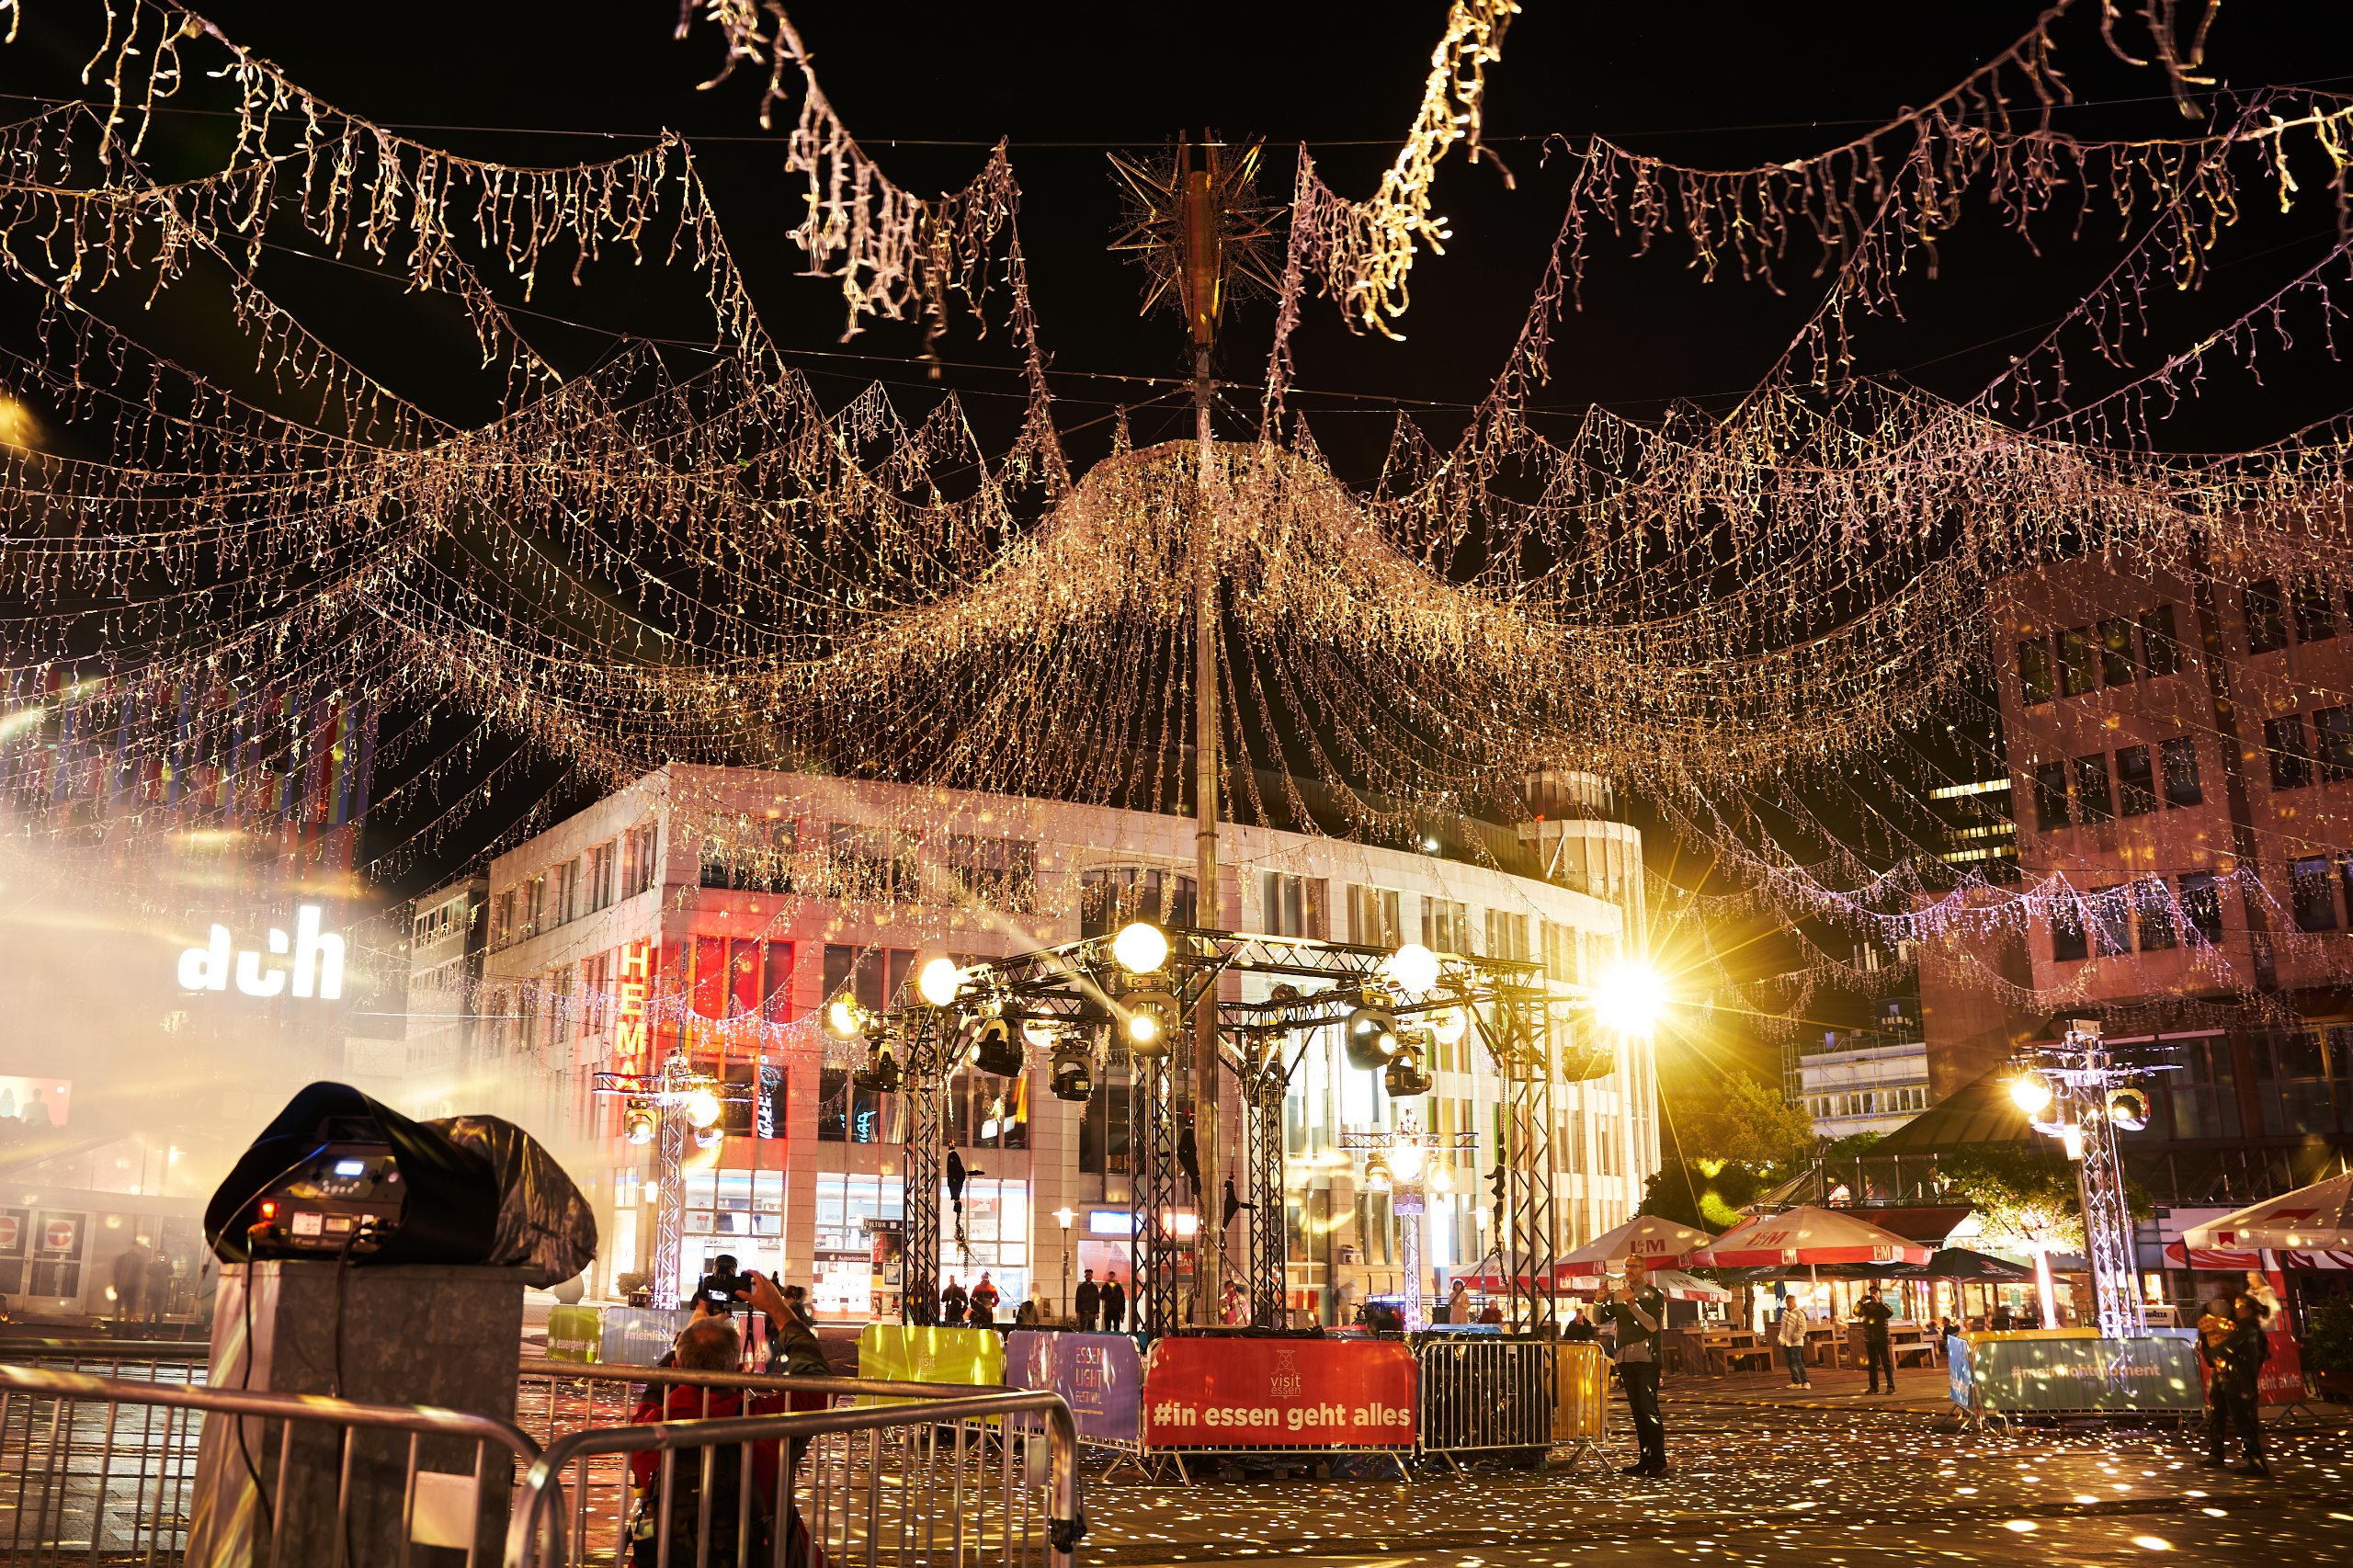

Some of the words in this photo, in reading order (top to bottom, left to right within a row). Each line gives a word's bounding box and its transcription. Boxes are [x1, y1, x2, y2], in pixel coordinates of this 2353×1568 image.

[615, 945, 649, 1092] HEMA
[1630, 1239, 1666, 1254] L&M
[1745, 1231, 1790, 1246] L&M
[1780, 1249, 1798, 1265] L&M
[1873, 1245, 1892, 1261] L&M
[1075, 1346, 1104, 1365] ESSEN
[1075, 1368, 1103, 1388] LIGHT
[1270, 1374, 1302, 1387] visit
[1271, 1385, 1302, 1395] essen
[1154, 1402, 1196, 1426] #in
[1204, 1406, 1279, 1426] essen
[1287, 1402, 1346, 1431] geht
[1353, 1402, 1411, 1426] alles
